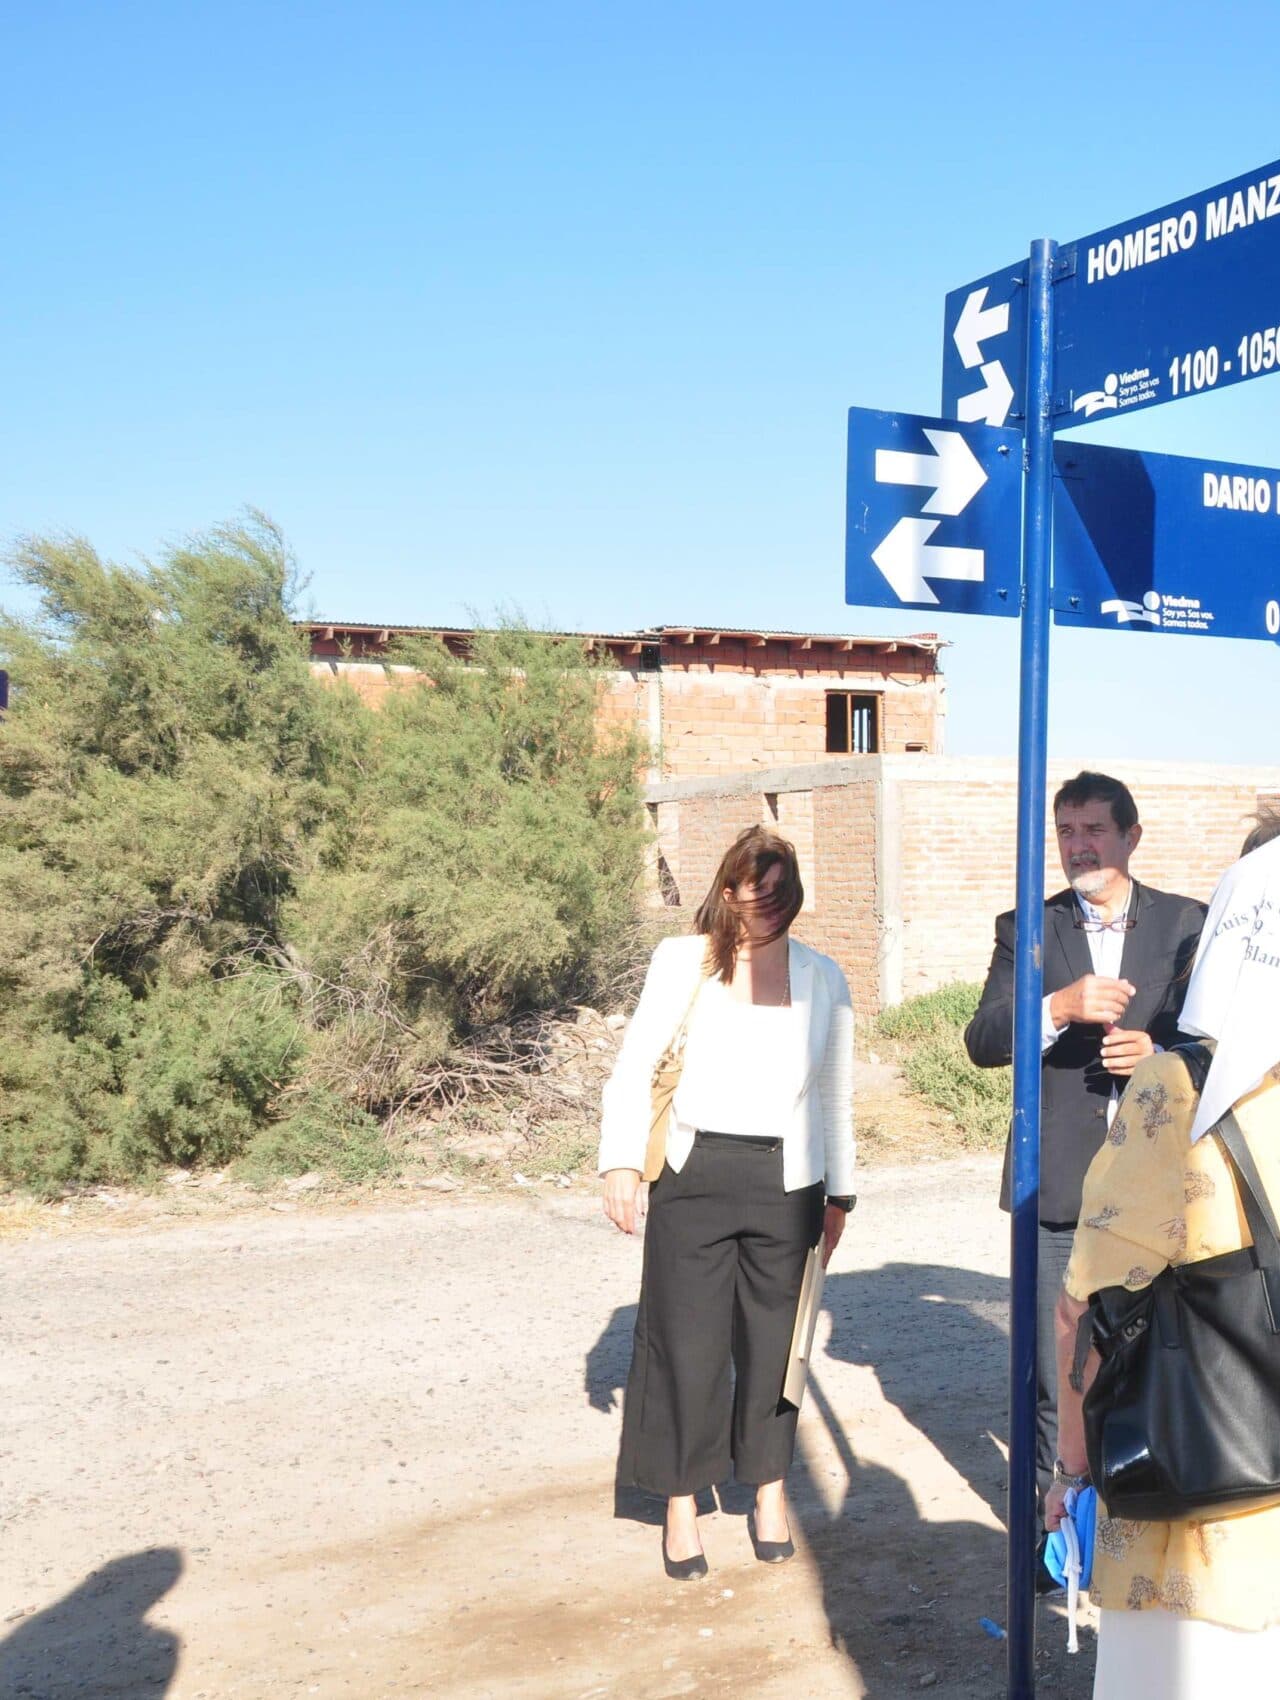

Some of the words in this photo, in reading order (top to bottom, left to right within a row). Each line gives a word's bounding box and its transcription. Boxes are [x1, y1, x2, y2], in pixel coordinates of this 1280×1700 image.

[1086, 209, 1198, 285] HOMERO
[1118, 367, 1150, 385] Viedma
[1168, 345, 1218, 396] 1100
[1223, 360, 1232, 371] -
[1202, 471, 1272, 513] DARIO
[1161, 595, 1201, 608] Viedma
[1265, 600, 1280, 635] 0
